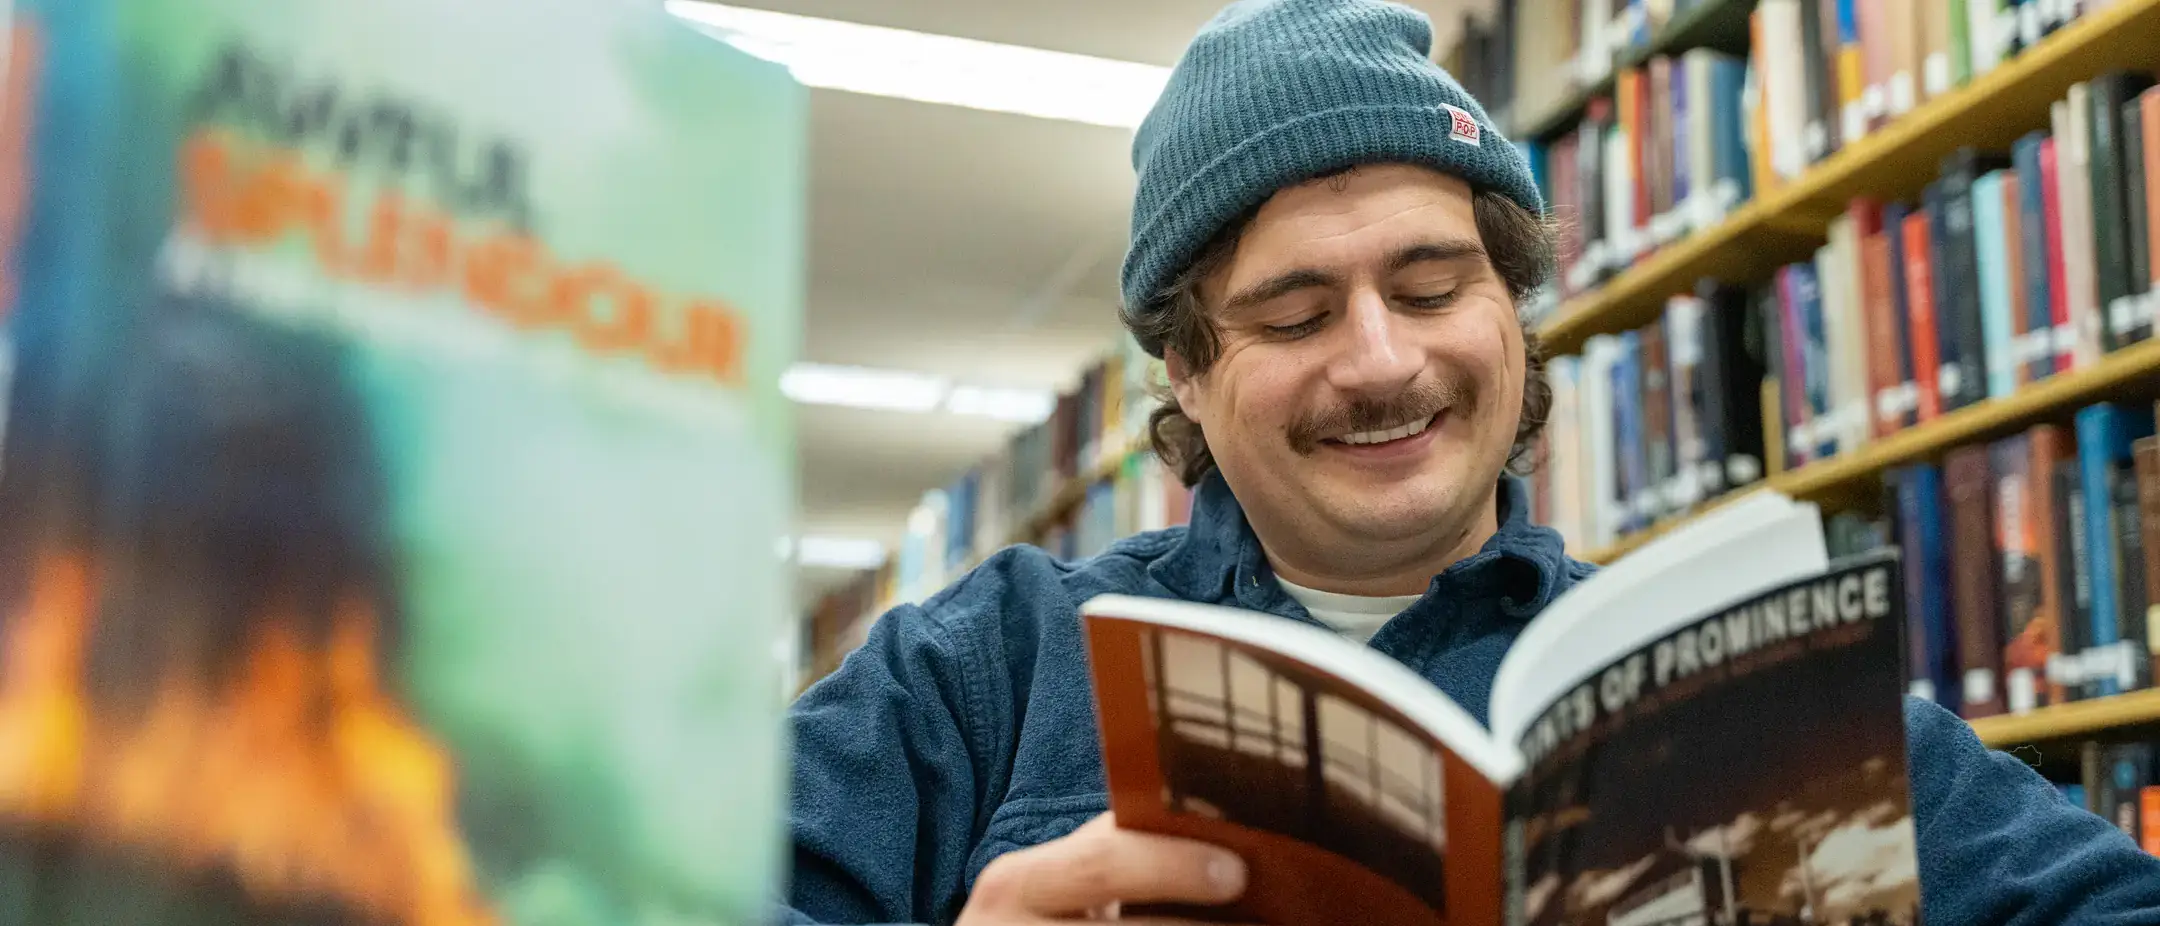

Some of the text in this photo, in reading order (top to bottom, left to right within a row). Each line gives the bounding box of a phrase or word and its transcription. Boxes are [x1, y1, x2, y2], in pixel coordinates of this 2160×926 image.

[1456, 121, 1476, 136] POP
[1600, 655, 1648, 713] OF
[1653, 567, 1890, 687] PROMINENCE
